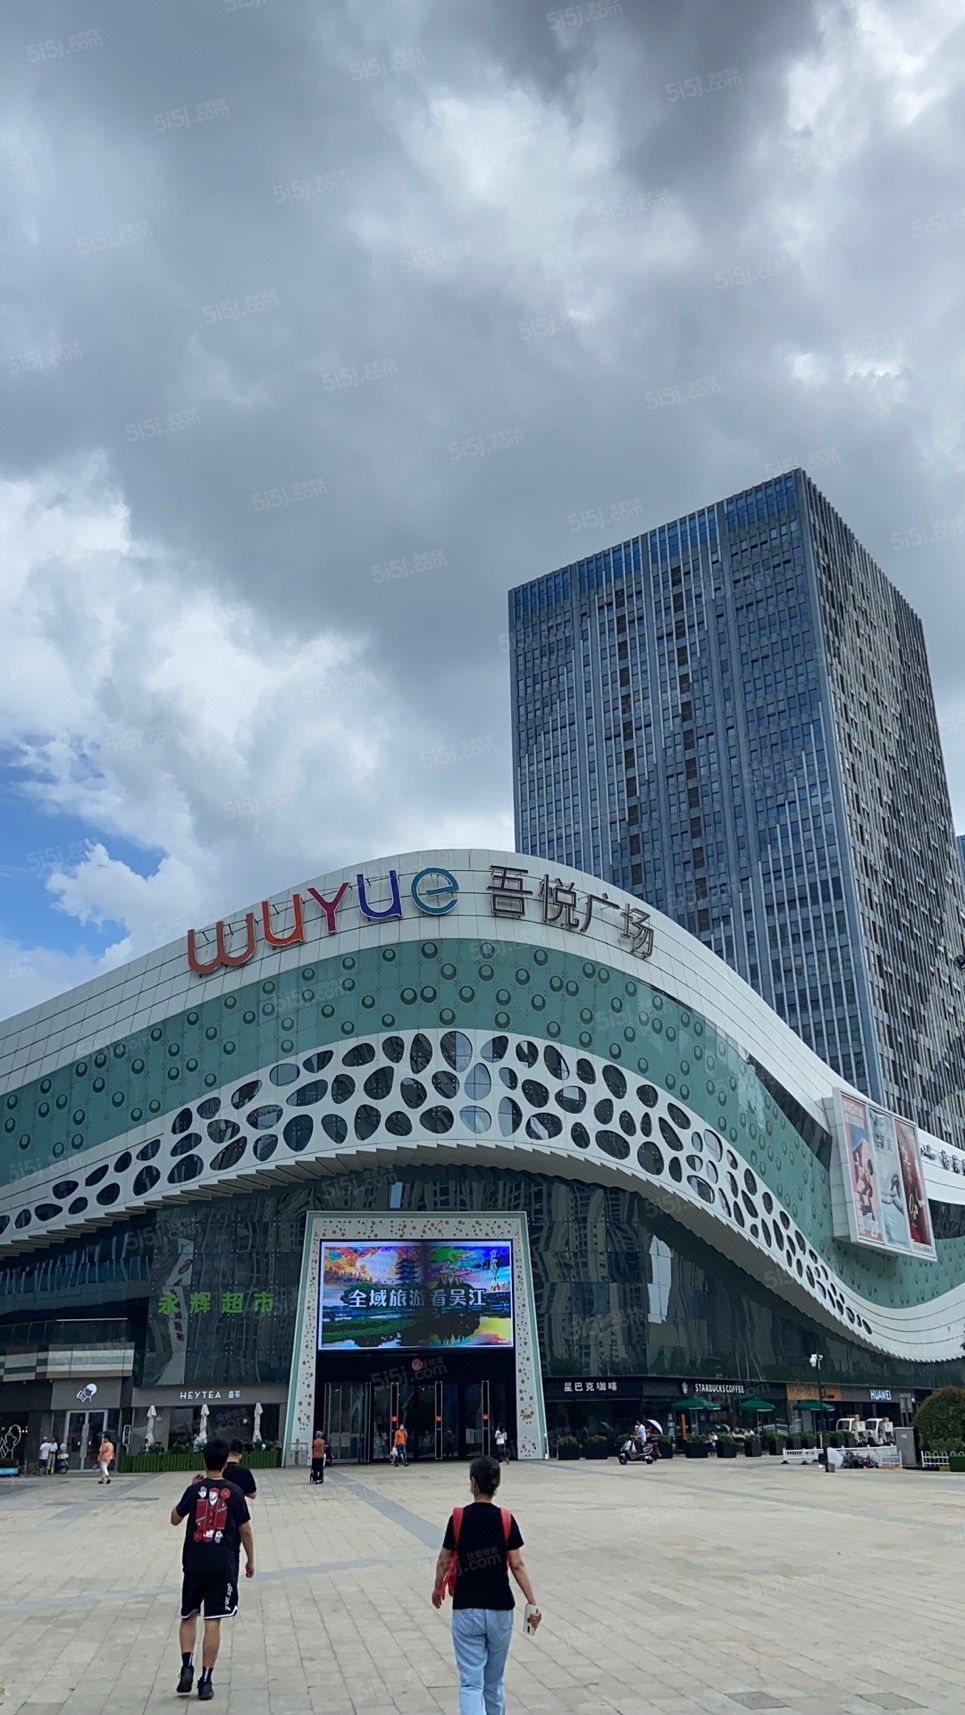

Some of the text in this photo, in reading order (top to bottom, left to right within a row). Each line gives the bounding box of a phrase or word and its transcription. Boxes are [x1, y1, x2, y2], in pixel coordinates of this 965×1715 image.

[486, 865, 656, 959] 吾悦广场
[158, 1291, 274, 1315] 永辉超市
[348, 1288, 487, 1308] 全域旅游看吴江
[563, 1381, 618, 1392] 星巴克咖啡
[180, 1391, 221, 1400] HEYTEA
[869, 1389, 893, 1400] HUAWEI
